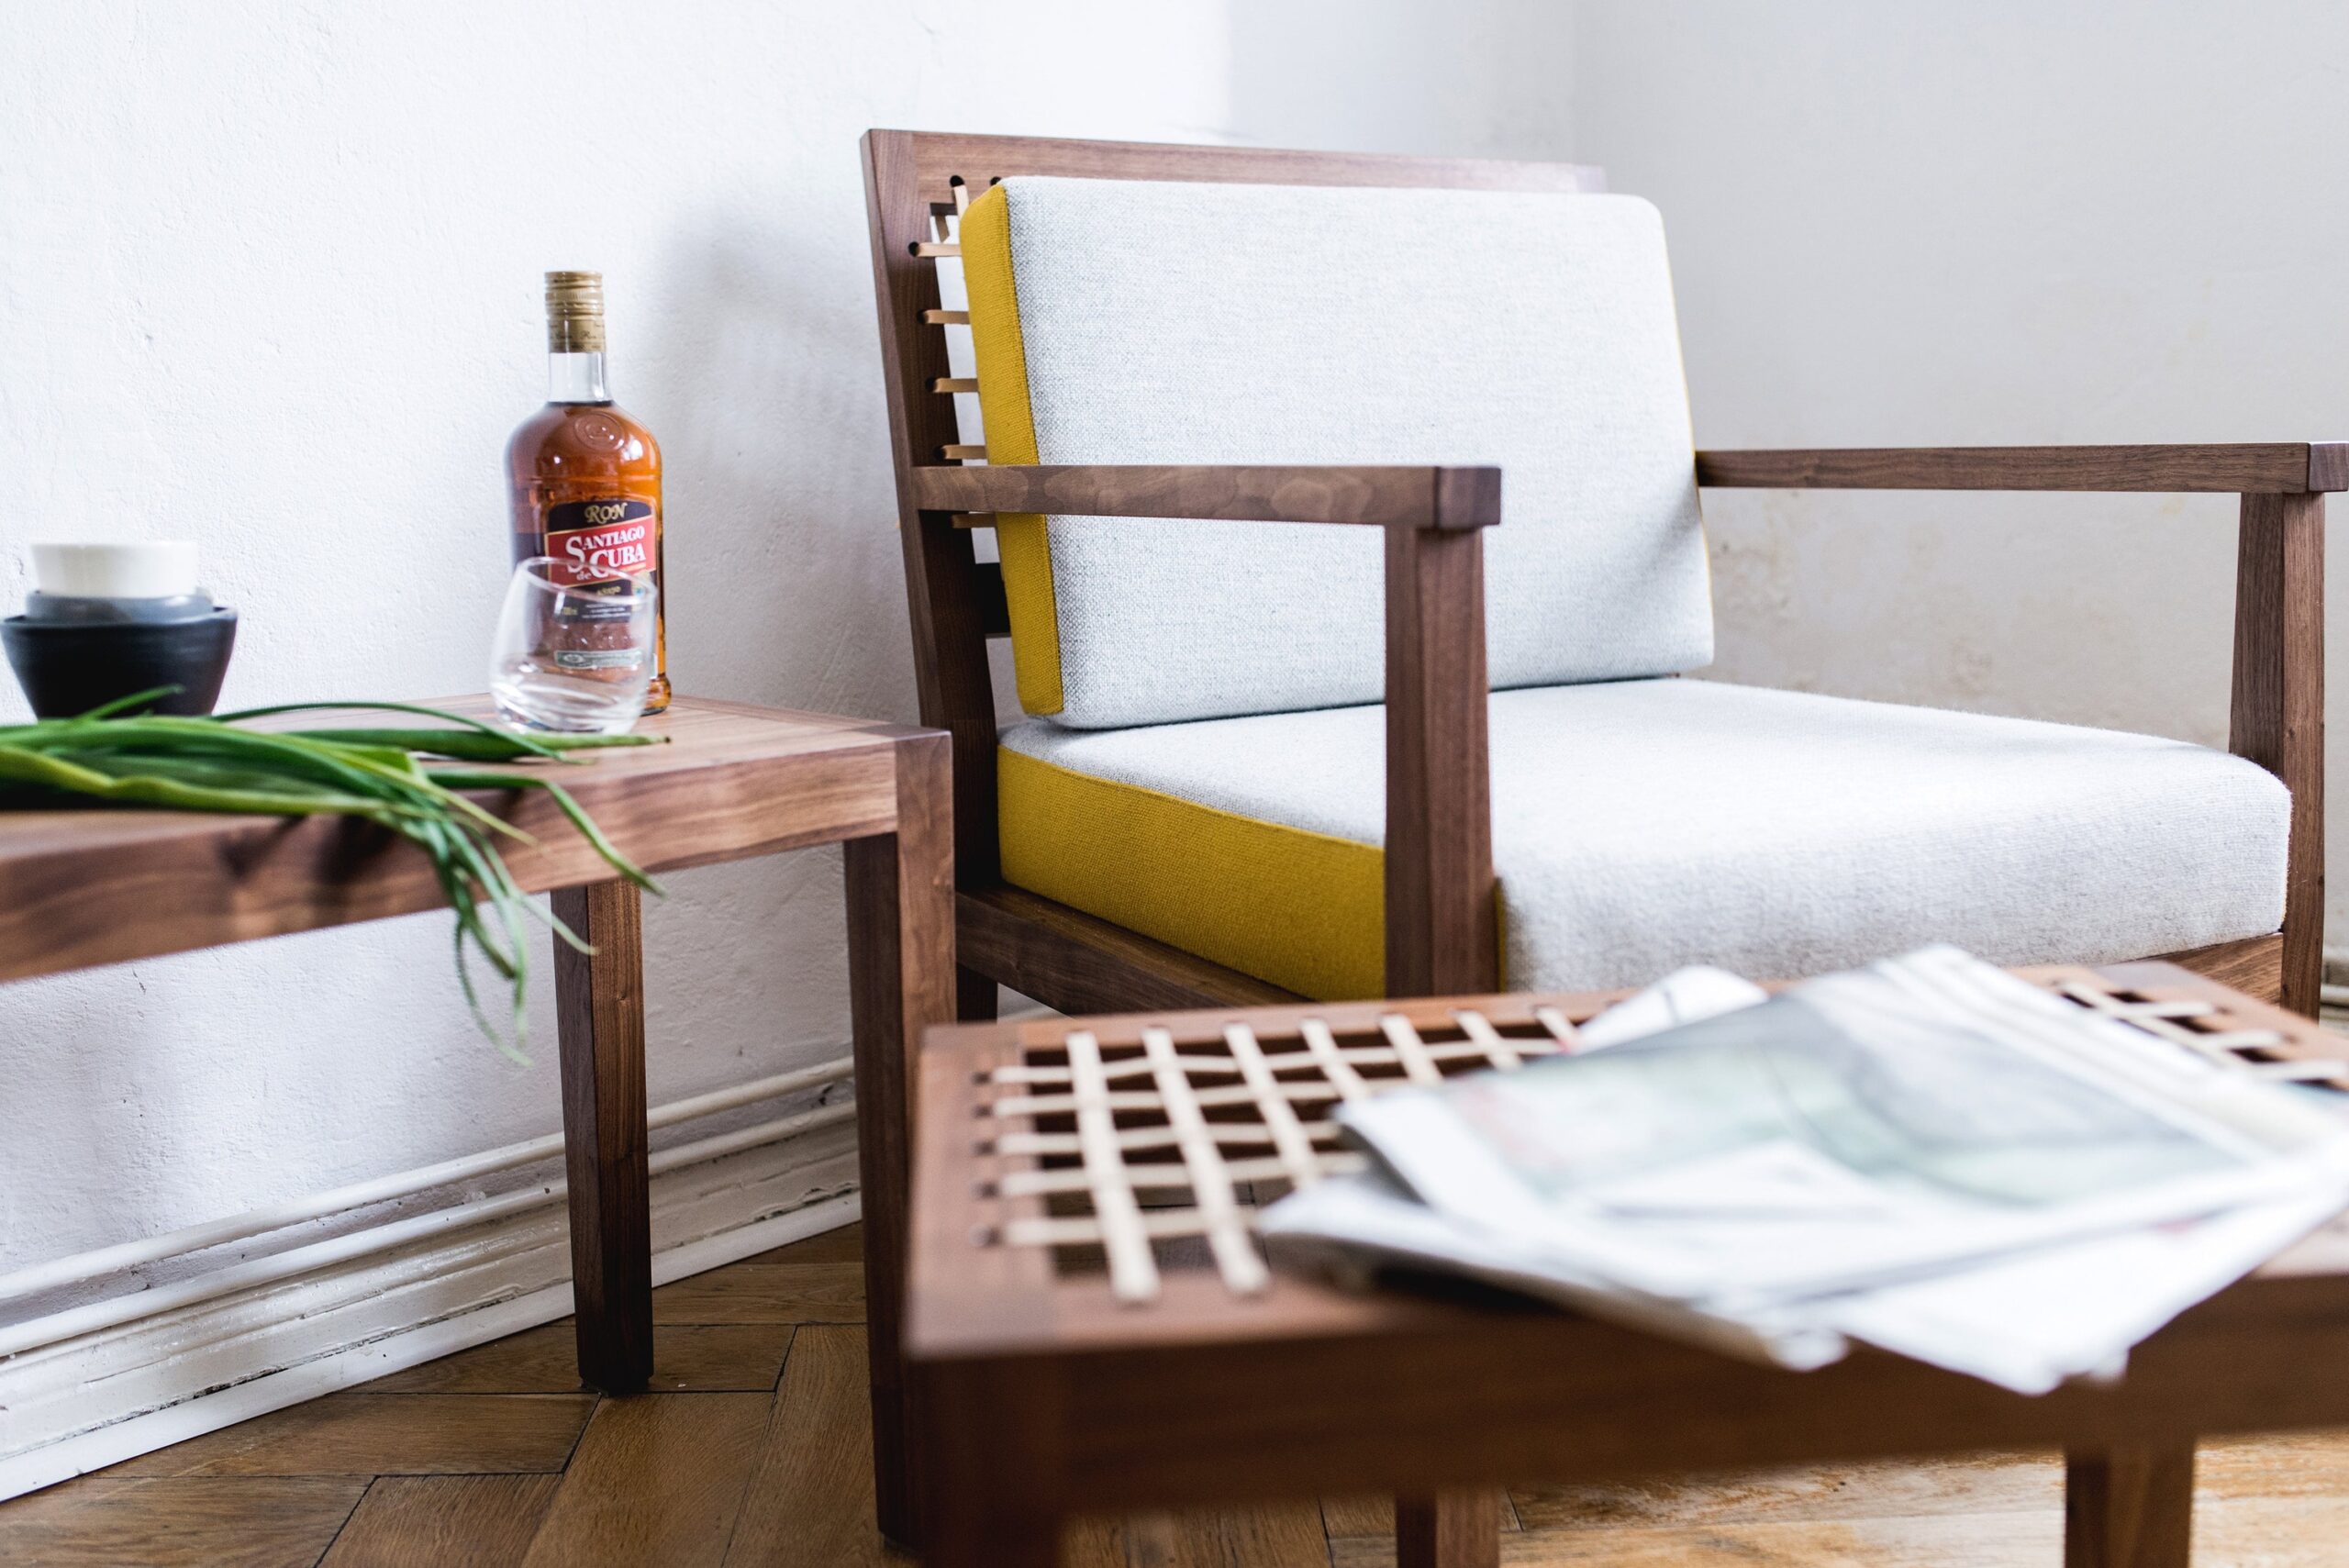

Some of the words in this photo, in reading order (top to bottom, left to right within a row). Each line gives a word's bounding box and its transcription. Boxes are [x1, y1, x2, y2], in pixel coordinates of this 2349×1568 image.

[584, 503, 628, 524] RON
[565, 526, 645, 573] SANTIAGO
[589, 543, 646, 578] CUBA
